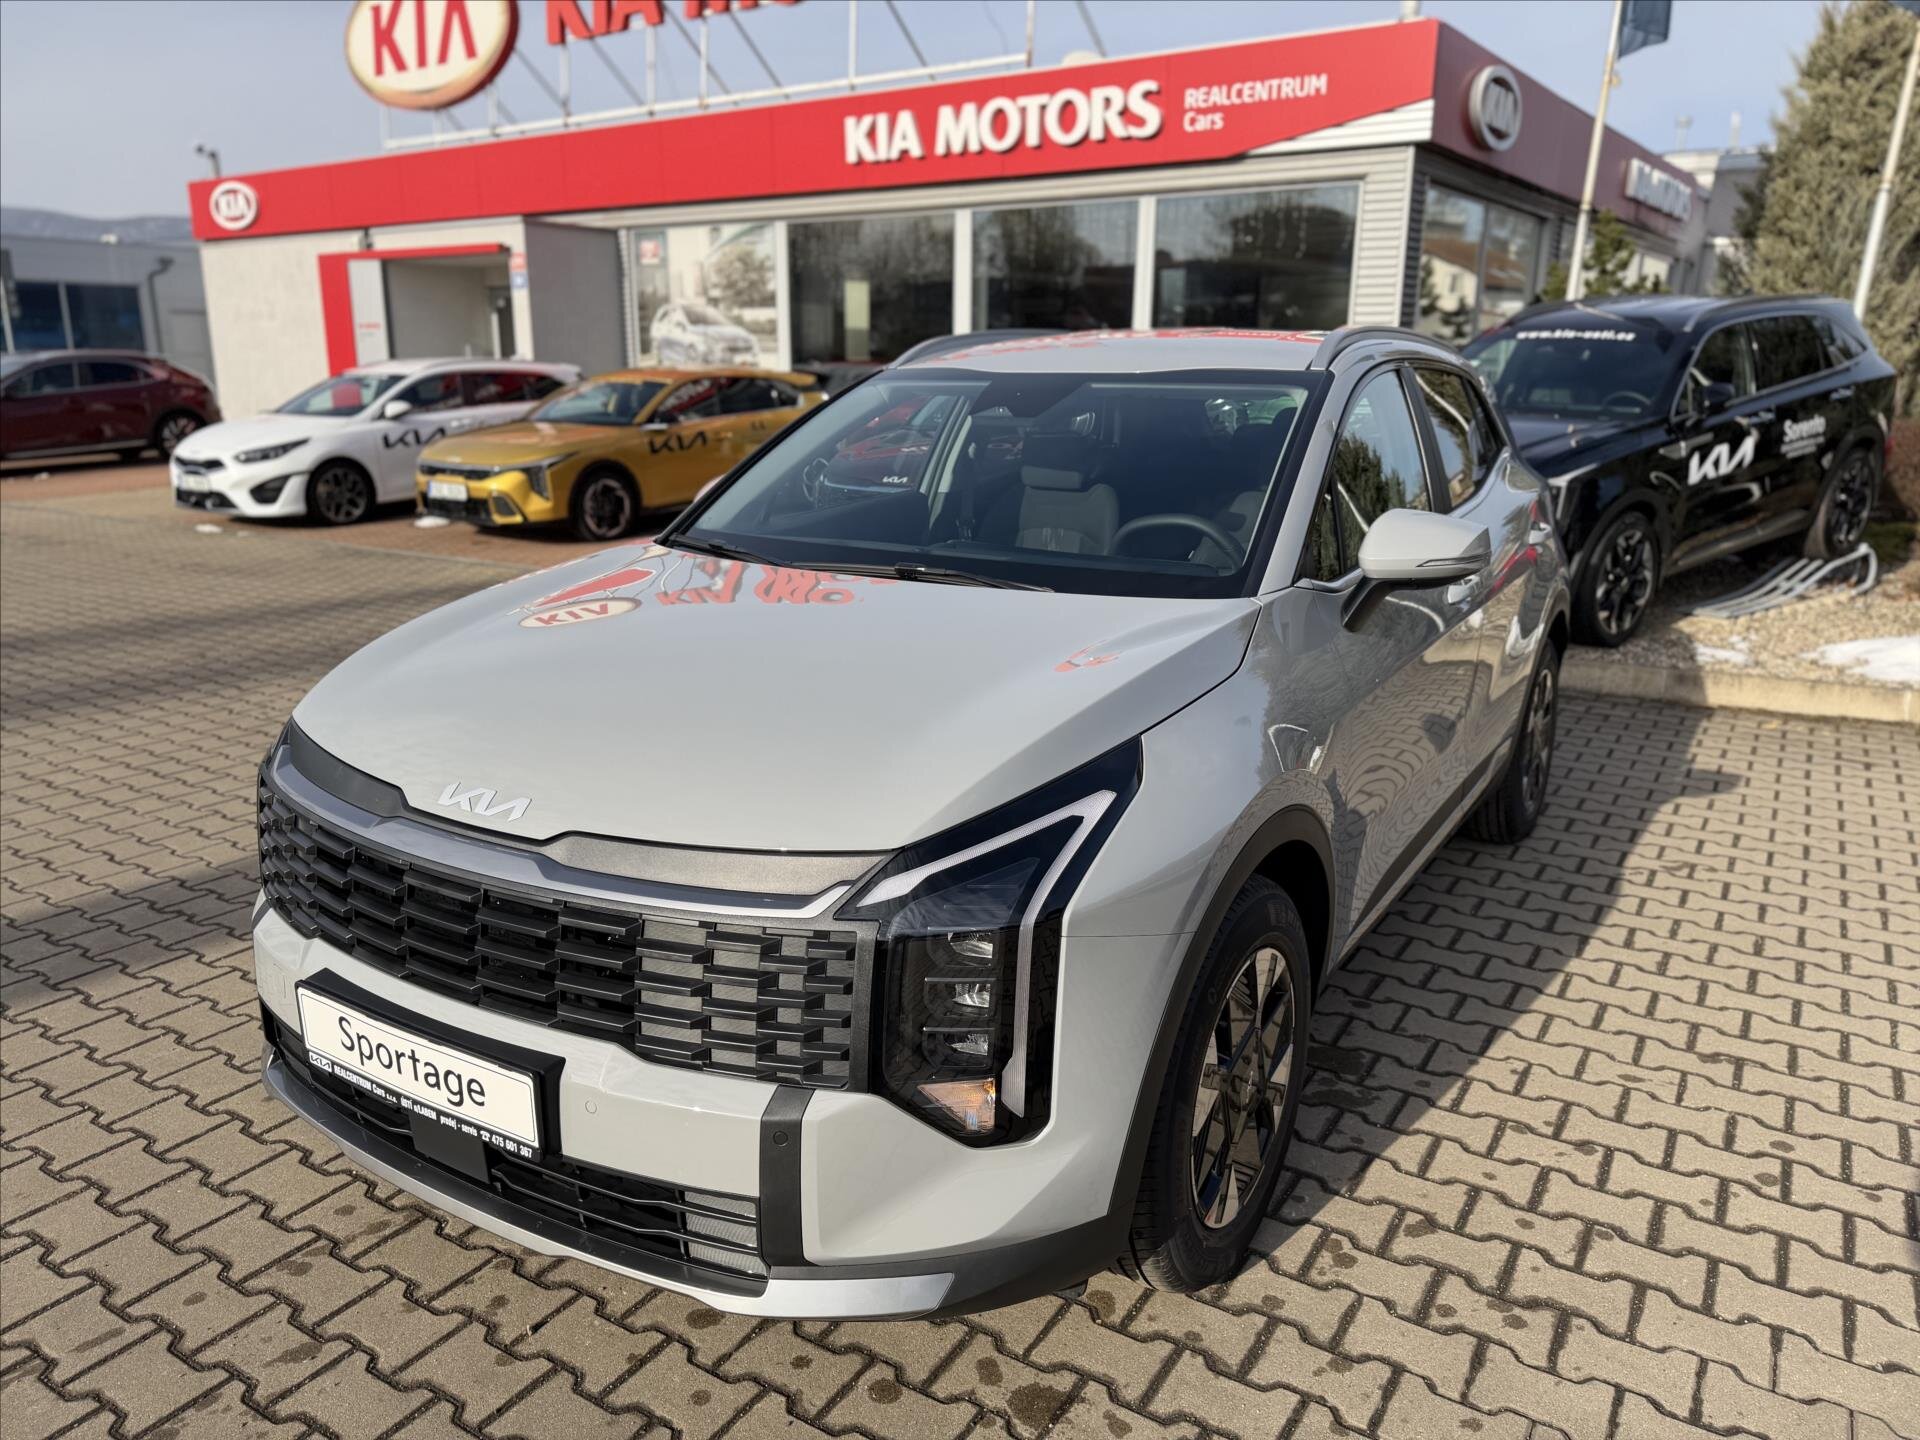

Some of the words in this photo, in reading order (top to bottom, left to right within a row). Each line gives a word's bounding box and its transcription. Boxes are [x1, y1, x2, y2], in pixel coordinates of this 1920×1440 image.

[371, 0, 477, 76] KIA
[1184, 73, 1329, 110] REALCENTRUM
[844, 109, 925, 165] KIA
[934, 79, 1163, 157] MOTORS
[1183, 110, 1225, 133] Cars
[647, 430, 708, 454] KIA
[1687, 434, 1756, 486] KIA
[438, 781, 533, 823] KIA
[338, 1015, 486, 1107] Sportage
[334, 1064, 372, 1091] REALCENTRUM
[372, 1083, 386, 1098] Cars
[491, 1134, 505, 1148] 475
